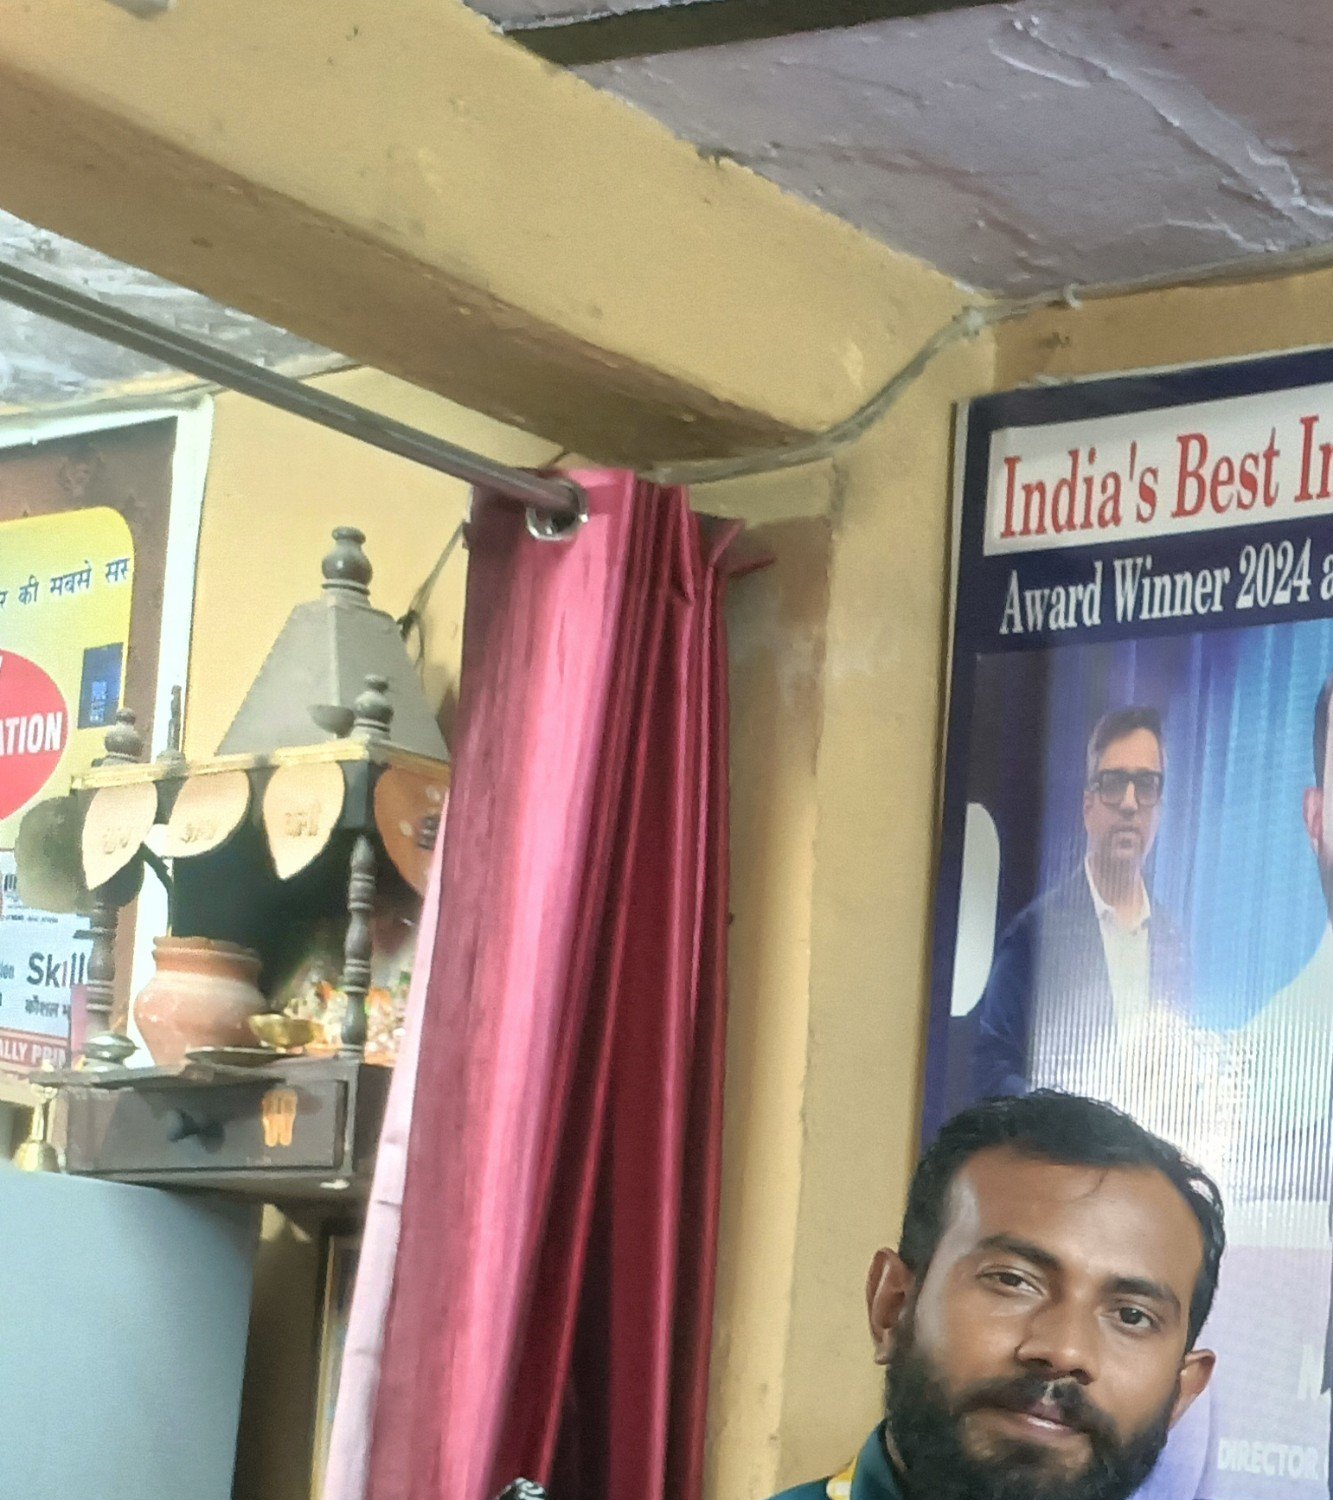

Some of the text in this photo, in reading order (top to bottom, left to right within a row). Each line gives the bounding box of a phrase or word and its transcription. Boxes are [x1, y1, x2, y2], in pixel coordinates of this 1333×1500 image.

[1001, 439, 1159, 538] India's
[1171, 427, 1280, 519] Best
[1000, 563, 1102, 635] Award
[1114, 555, 1231, 621] Winner
[1236, 539, 1312, 610] 2024
[1217, 1437, 1319, 1480] DIRECTOR
